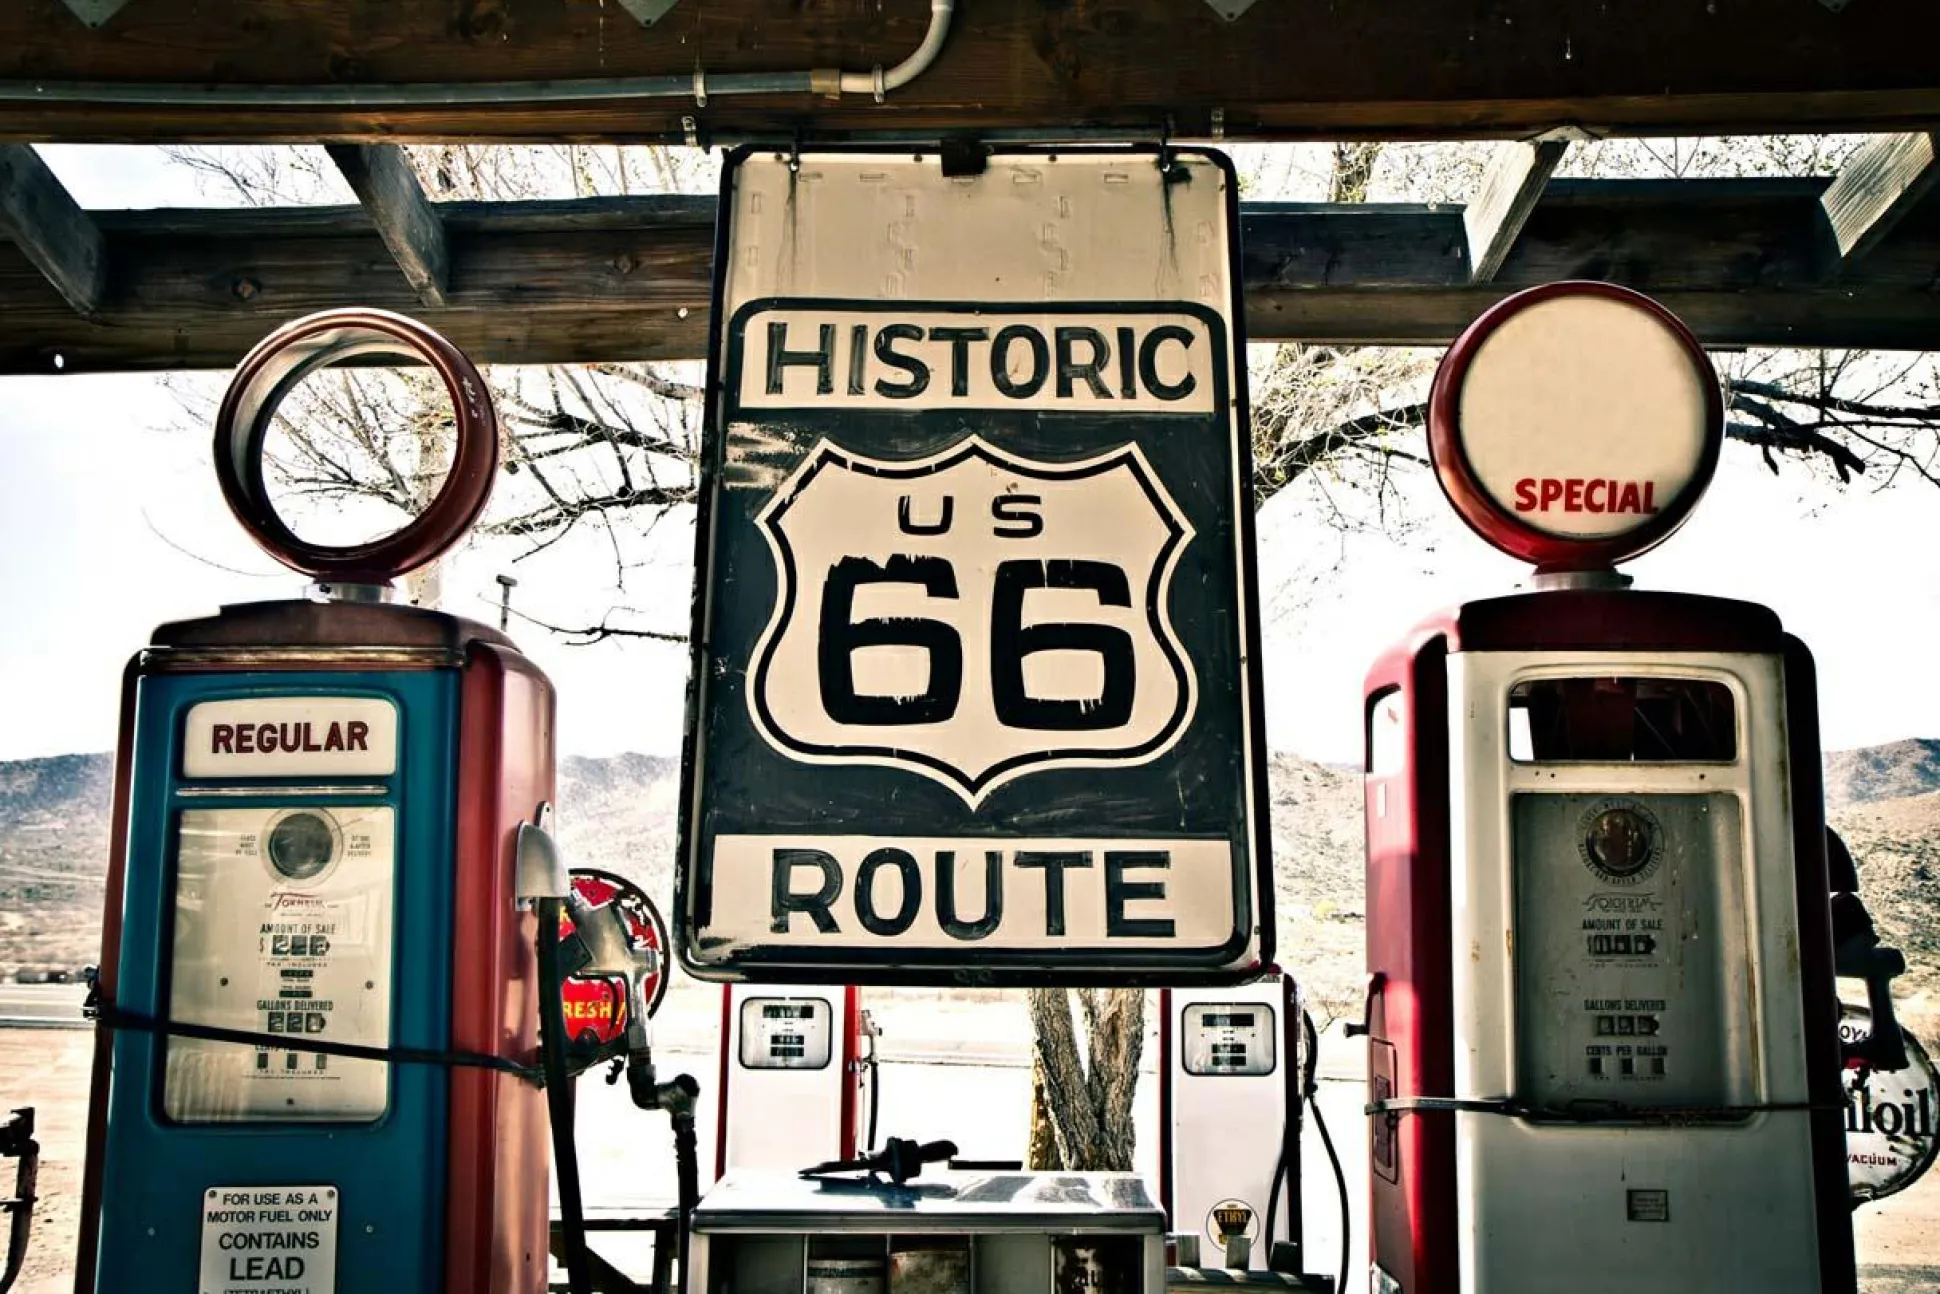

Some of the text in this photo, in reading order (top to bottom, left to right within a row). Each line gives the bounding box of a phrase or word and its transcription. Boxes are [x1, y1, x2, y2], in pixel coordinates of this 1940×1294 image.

[765, 322, 1197, 400] HISTORIC
[1515, 478, 1659, 514] SPECIAL
[818, 553, 1136, 731] 66
[212, 721, 369, 753] REGULAR
[770, 847, 1176, 940] ROUTE
[259, 923, 336, 934] AMOUNT OF SALE
[1583, 918, 1663, 931] AMOUNT OF SALE
[257, 1000, 334, 1011] GALLONS DELIVERED
[1584, 999, 1666, 1011] GALLONS DELIVERED
[223, 1193, 318, 1206] FOR USE AS A
[207, 1210, 332, 1222] MOTOR FUEL ONLY
[219, 1232, 320, 1250] CONTAINS
[230, 1257, 305, 1281] LEAD
